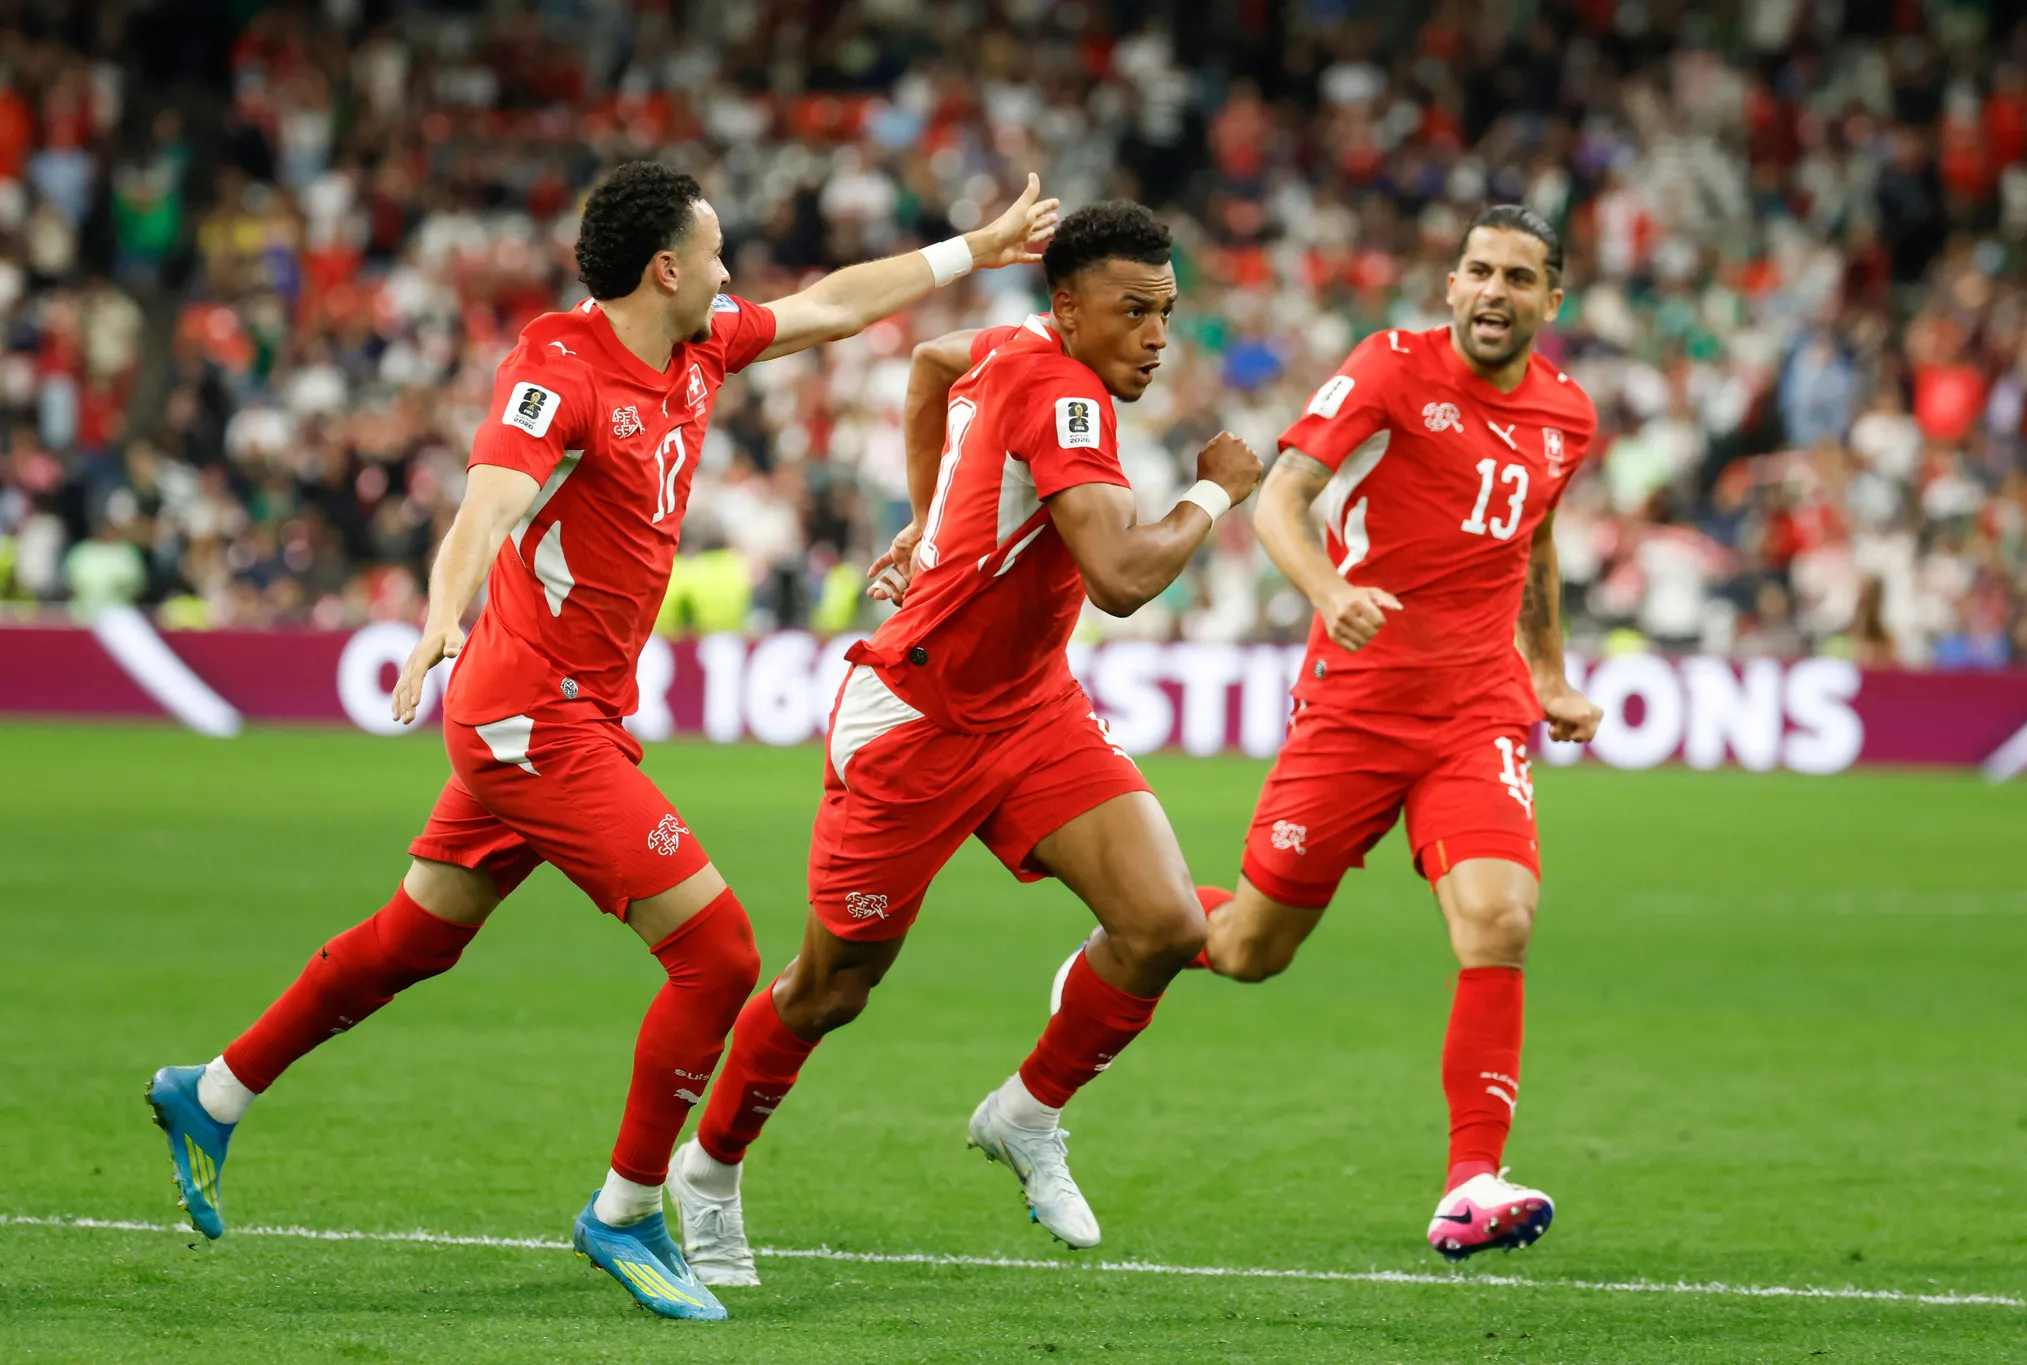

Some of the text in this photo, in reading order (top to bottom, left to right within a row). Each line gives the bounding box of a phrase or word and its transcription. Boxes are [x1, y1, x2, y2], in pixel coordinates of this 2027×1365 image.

[513, 417, 534, 430] 2026
[652, 425, 686, 525] 17
[1461, 458, 1529, 540] 13
